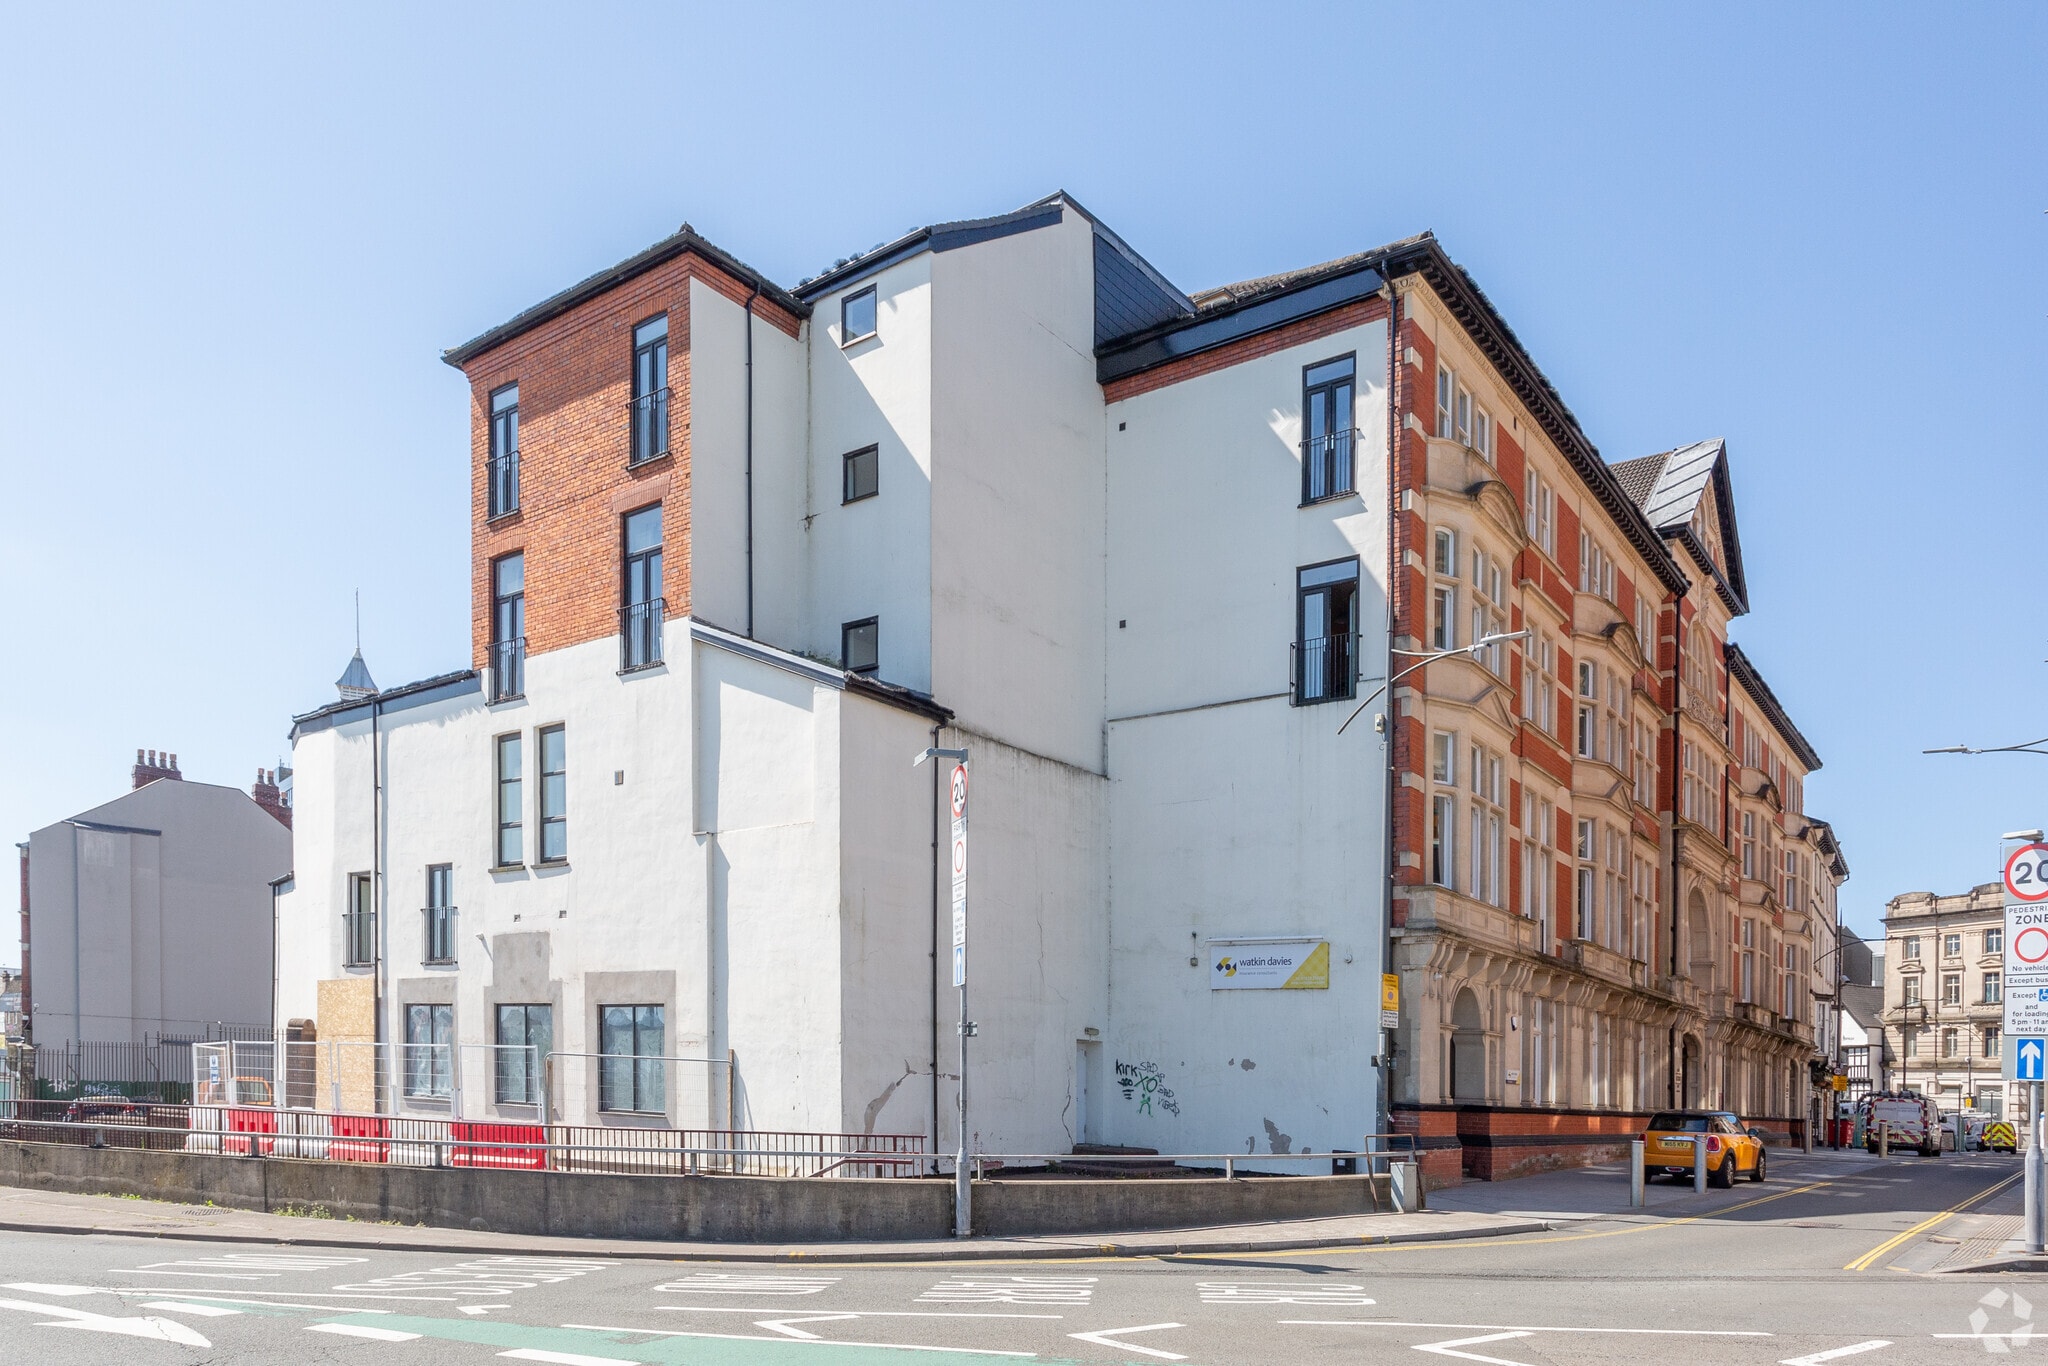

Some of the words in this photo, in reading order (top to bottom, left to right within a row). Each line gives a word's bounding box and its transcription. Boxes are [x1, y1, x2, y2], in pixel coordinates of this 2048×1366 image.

[954, 779, 965, 803] 20
[2015, 914, 2048, 925] ZONE
[1240, 956, 1266, 966] watkin
[1267, 956, 1292, 966] davies
[2009, 977, 2033, 985] Except
[2034, 1025, 2046, 1033] day
[107, 1253, 370, 1280] ONLY
[332, 1256, 622, 1295] ACCESS
[653, 1273, 843, 1295] AND
[912, 1275, 1099, 1306] PARK
[1195, 1281, 1377, 1305] CAR
